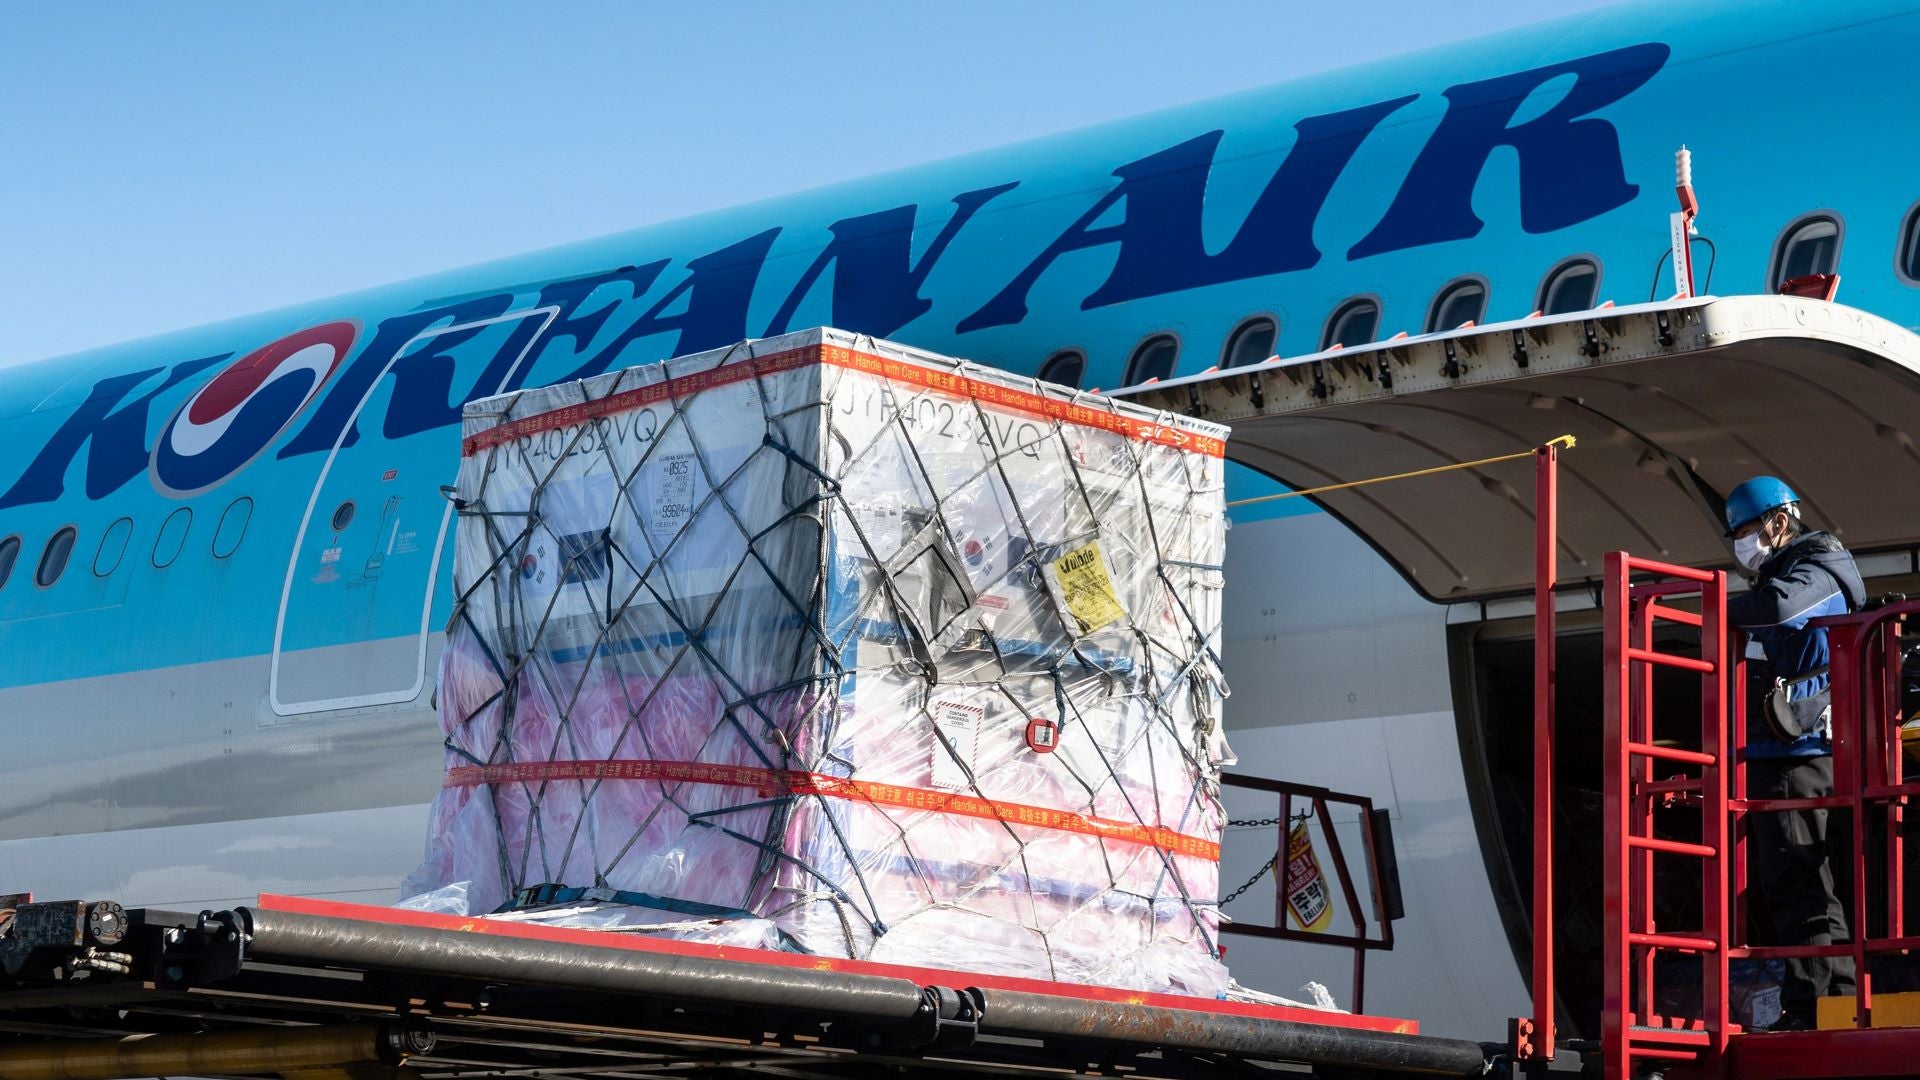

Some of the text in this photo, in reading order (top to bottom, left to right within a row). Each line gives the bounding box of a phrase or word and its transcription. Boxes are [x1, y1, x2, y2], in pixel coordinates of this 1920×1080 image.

[955, 42, 1671, 334] AIR
[712, 369, 735, 383] Handle
[855, 353, 882, 372] Handle
[884, 363, 900, 376] with
[1001, 391, 1026, 407] Handle
[1027, 398, 1041, 411] with
[666, 767, 692, 779] Handle
[693, 767, 709, 780] with
[951, 798, 977, 813] Handle
[979, 803, 994, 815] with
